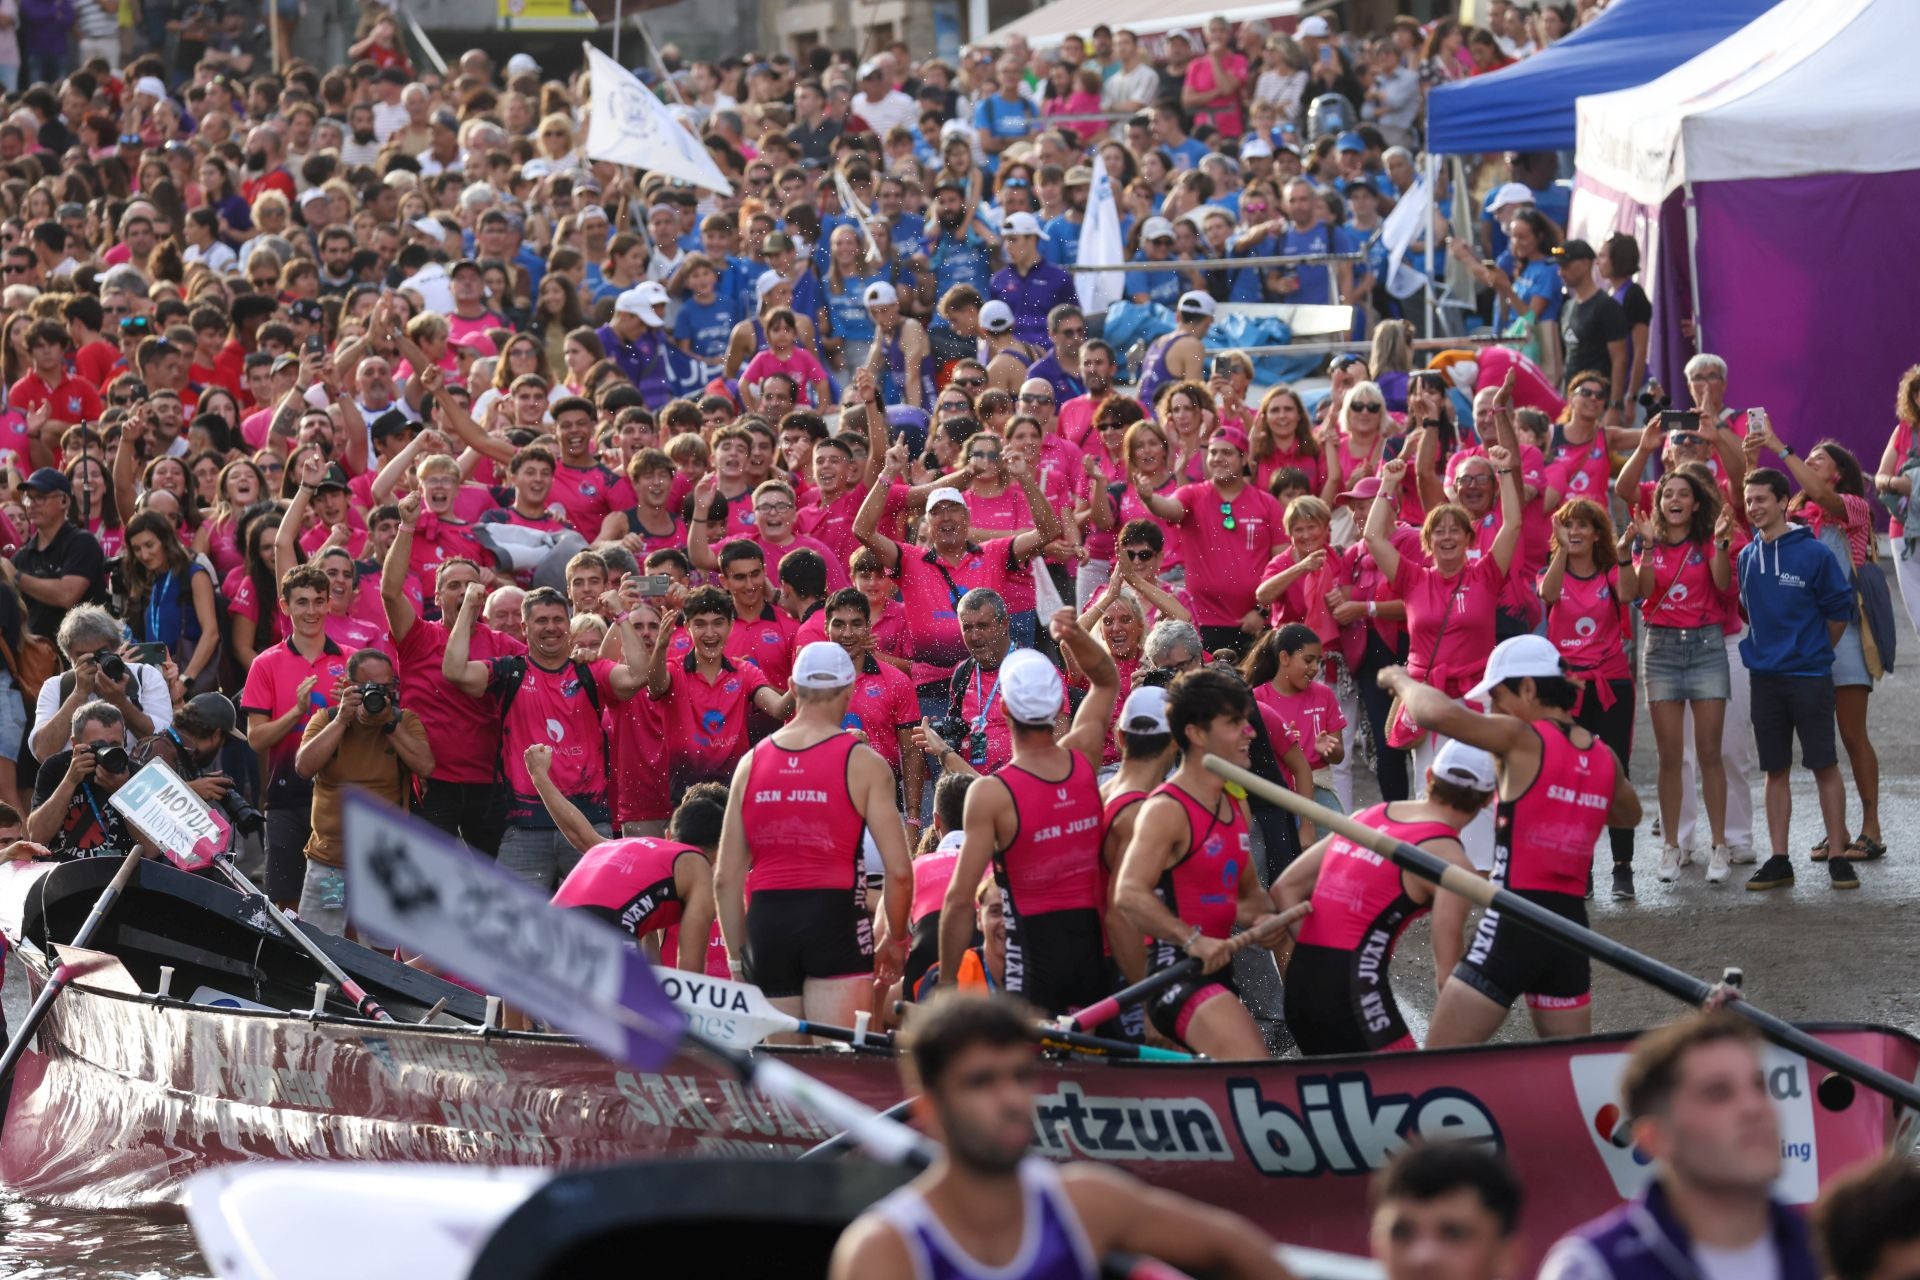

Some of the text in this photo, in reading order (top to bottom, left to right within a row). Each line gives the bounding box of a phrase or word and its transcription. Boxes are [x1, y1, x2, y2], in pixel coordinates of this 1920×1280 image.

[156, 784, 214, 837] MOYUA
[755, 789, 828, 803] SAN JUAN
[1547, 785, 1608, 810] SAN JUAN
[142, 804, 189, 851] Homes
[1034, 816, 1098, 842] SAN JUAN
[856, 917, 873, 956] SAN
[1004, 936, 1024, 992] JUAN
[1358, 929, 1391, 1033] JUAN SAN
[660, 976, 750, 1014] OYUA
[615, 1072, 717, 1138] SAN
[1229, 1075, 1501, 1176] bike
